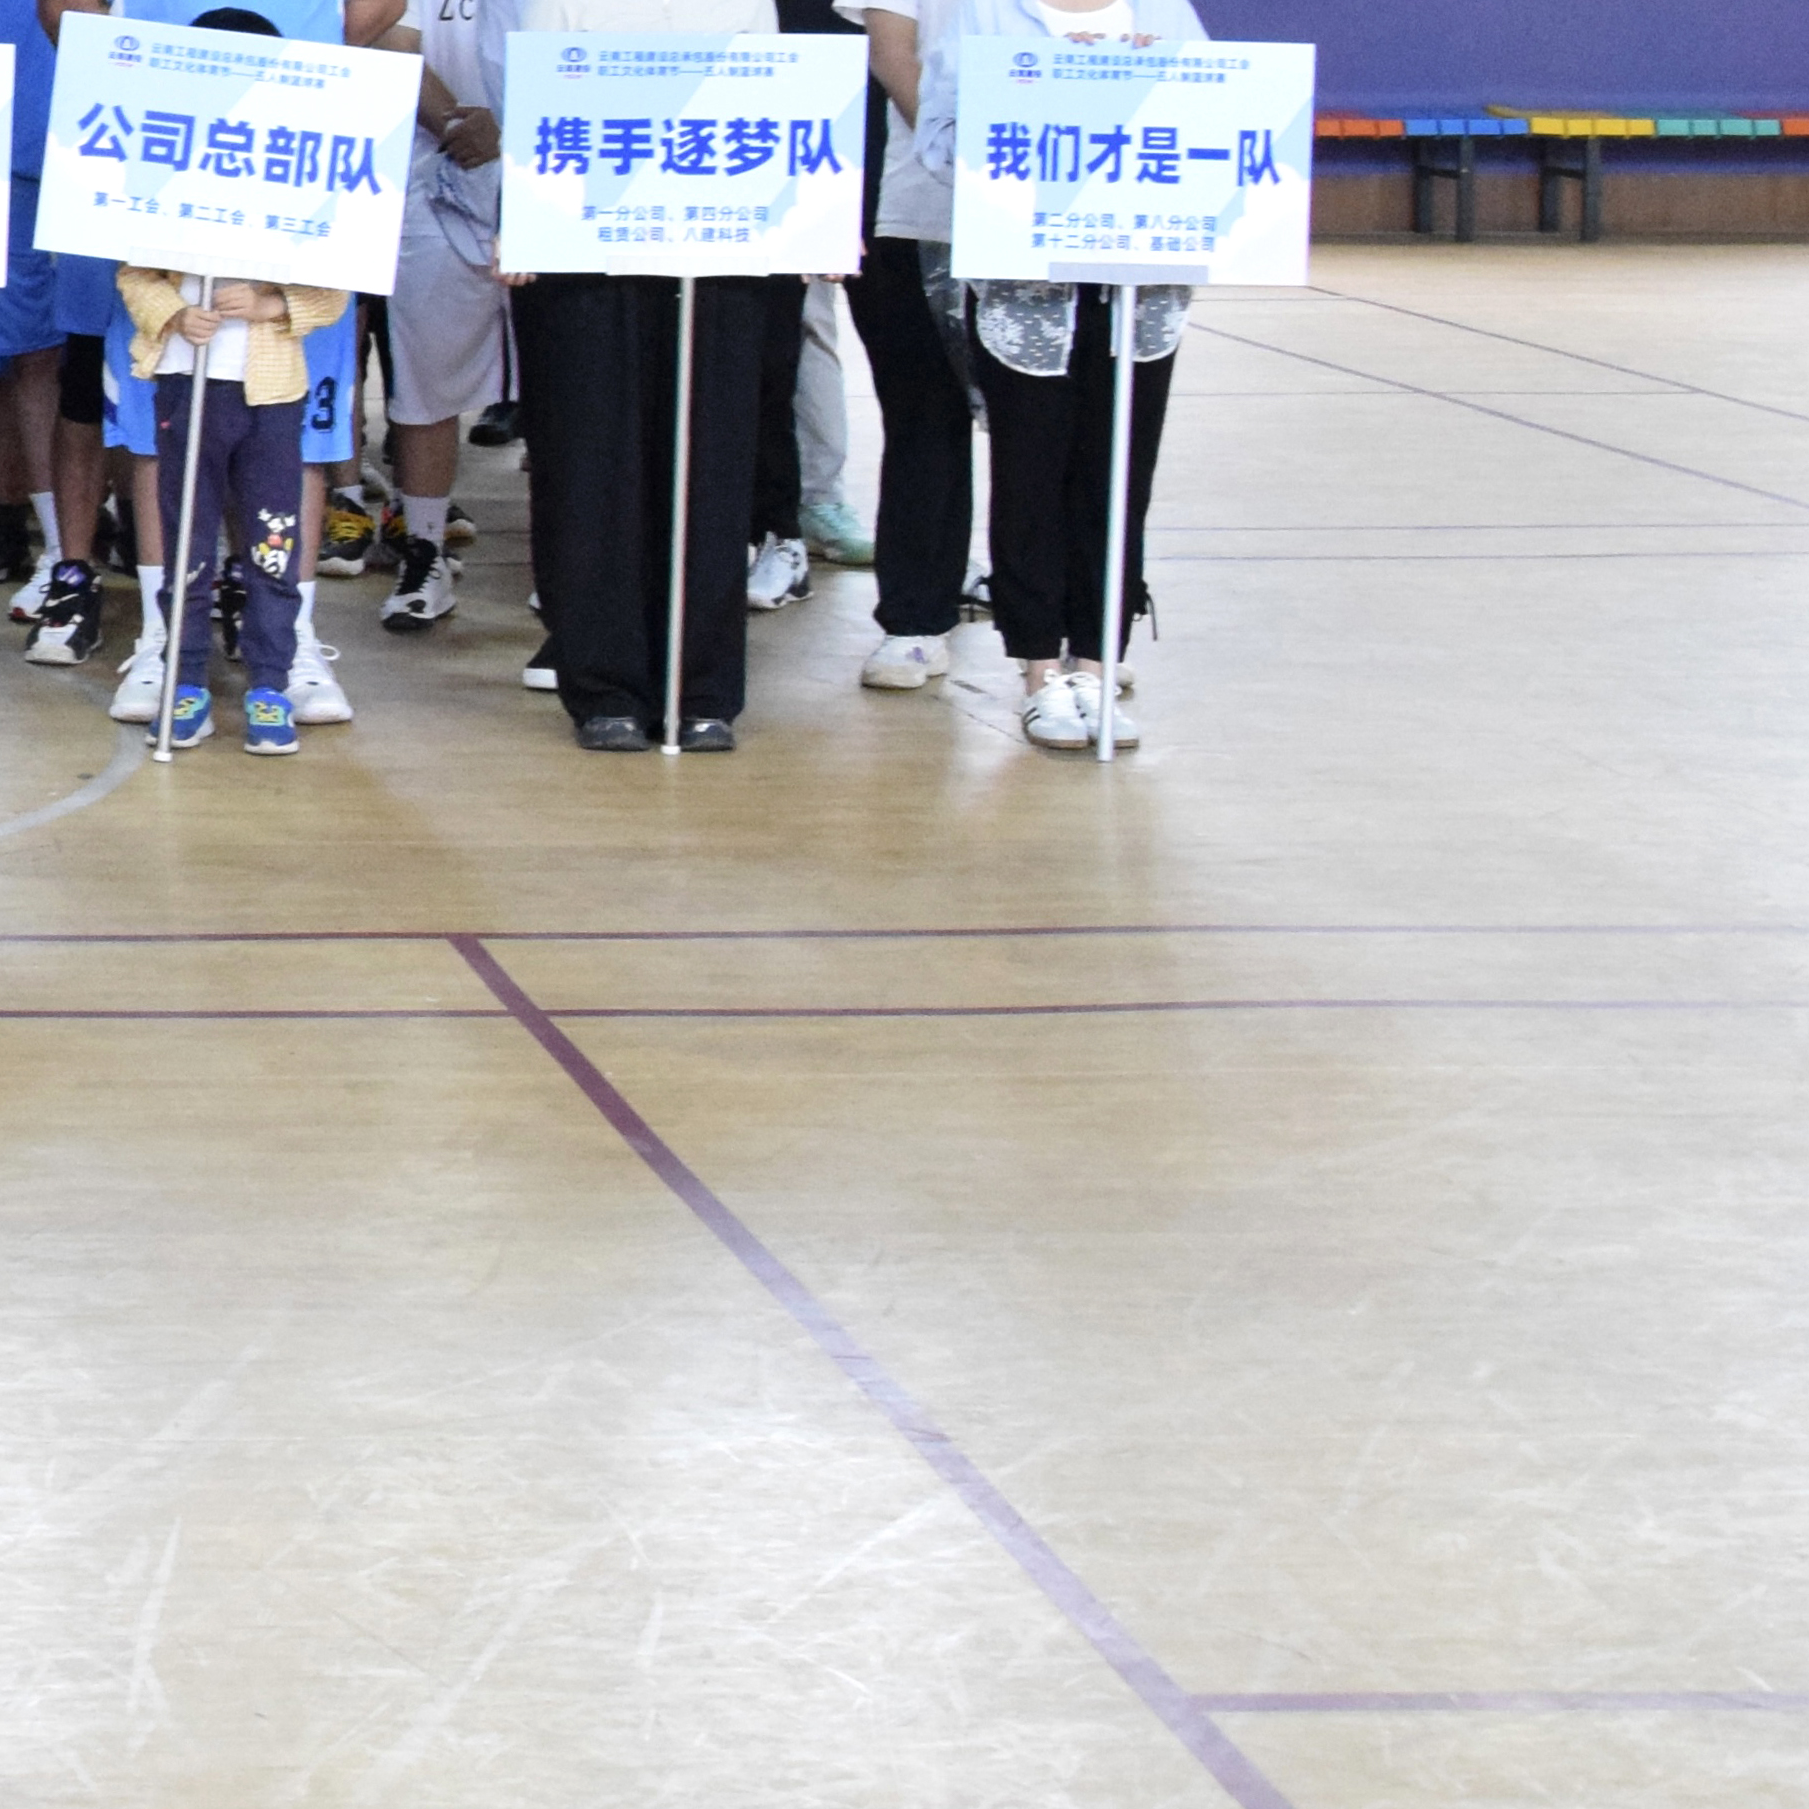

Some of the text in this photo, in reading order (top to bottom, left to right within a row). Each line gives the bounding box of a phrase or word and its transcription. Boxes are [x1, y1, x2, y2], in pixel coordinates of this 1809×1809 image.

[77, 102, 381, 196] 公司总部队
[534, 117, 843, 177] 携手逐梦队
[987, 121, 1280, 187] 我们才是一队
